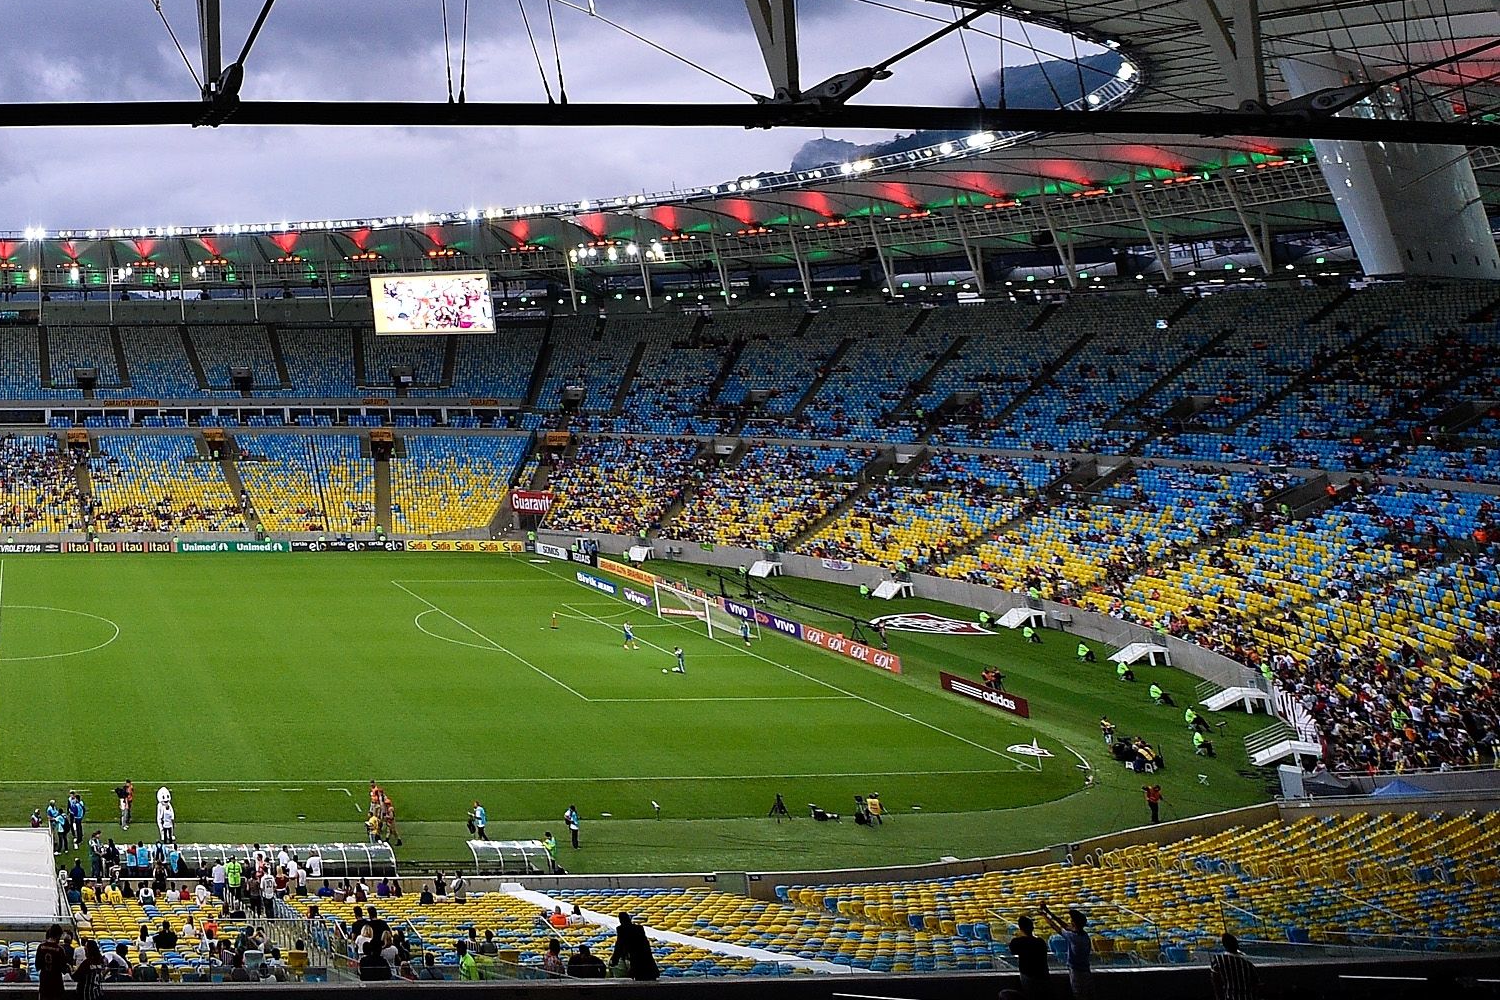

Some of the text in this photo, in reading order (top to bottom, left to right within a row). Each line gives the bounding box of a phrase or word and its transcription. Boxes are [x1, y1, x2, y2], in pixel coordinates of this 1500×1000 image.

[26, 544, 41, 552] 2014
[68, 542, 169, 552] Itaú Itaú Itaú Itaú
[182, 543, 271, 551] Unimed Unimed
[309, 541, 327, 551] elo
[347, 541, 366, 551] elo
[385, 541, 404, 551] elo
[408, 541, 427, 550] Sadia
[432, 541, 450, 550] Sadia
[455, 541, 474, 551] Sadia
[479, 542, 498, 551] Sadia
[542, 545, 560, 557] SOMOS
[982, 691, 1016, 710] adidas
